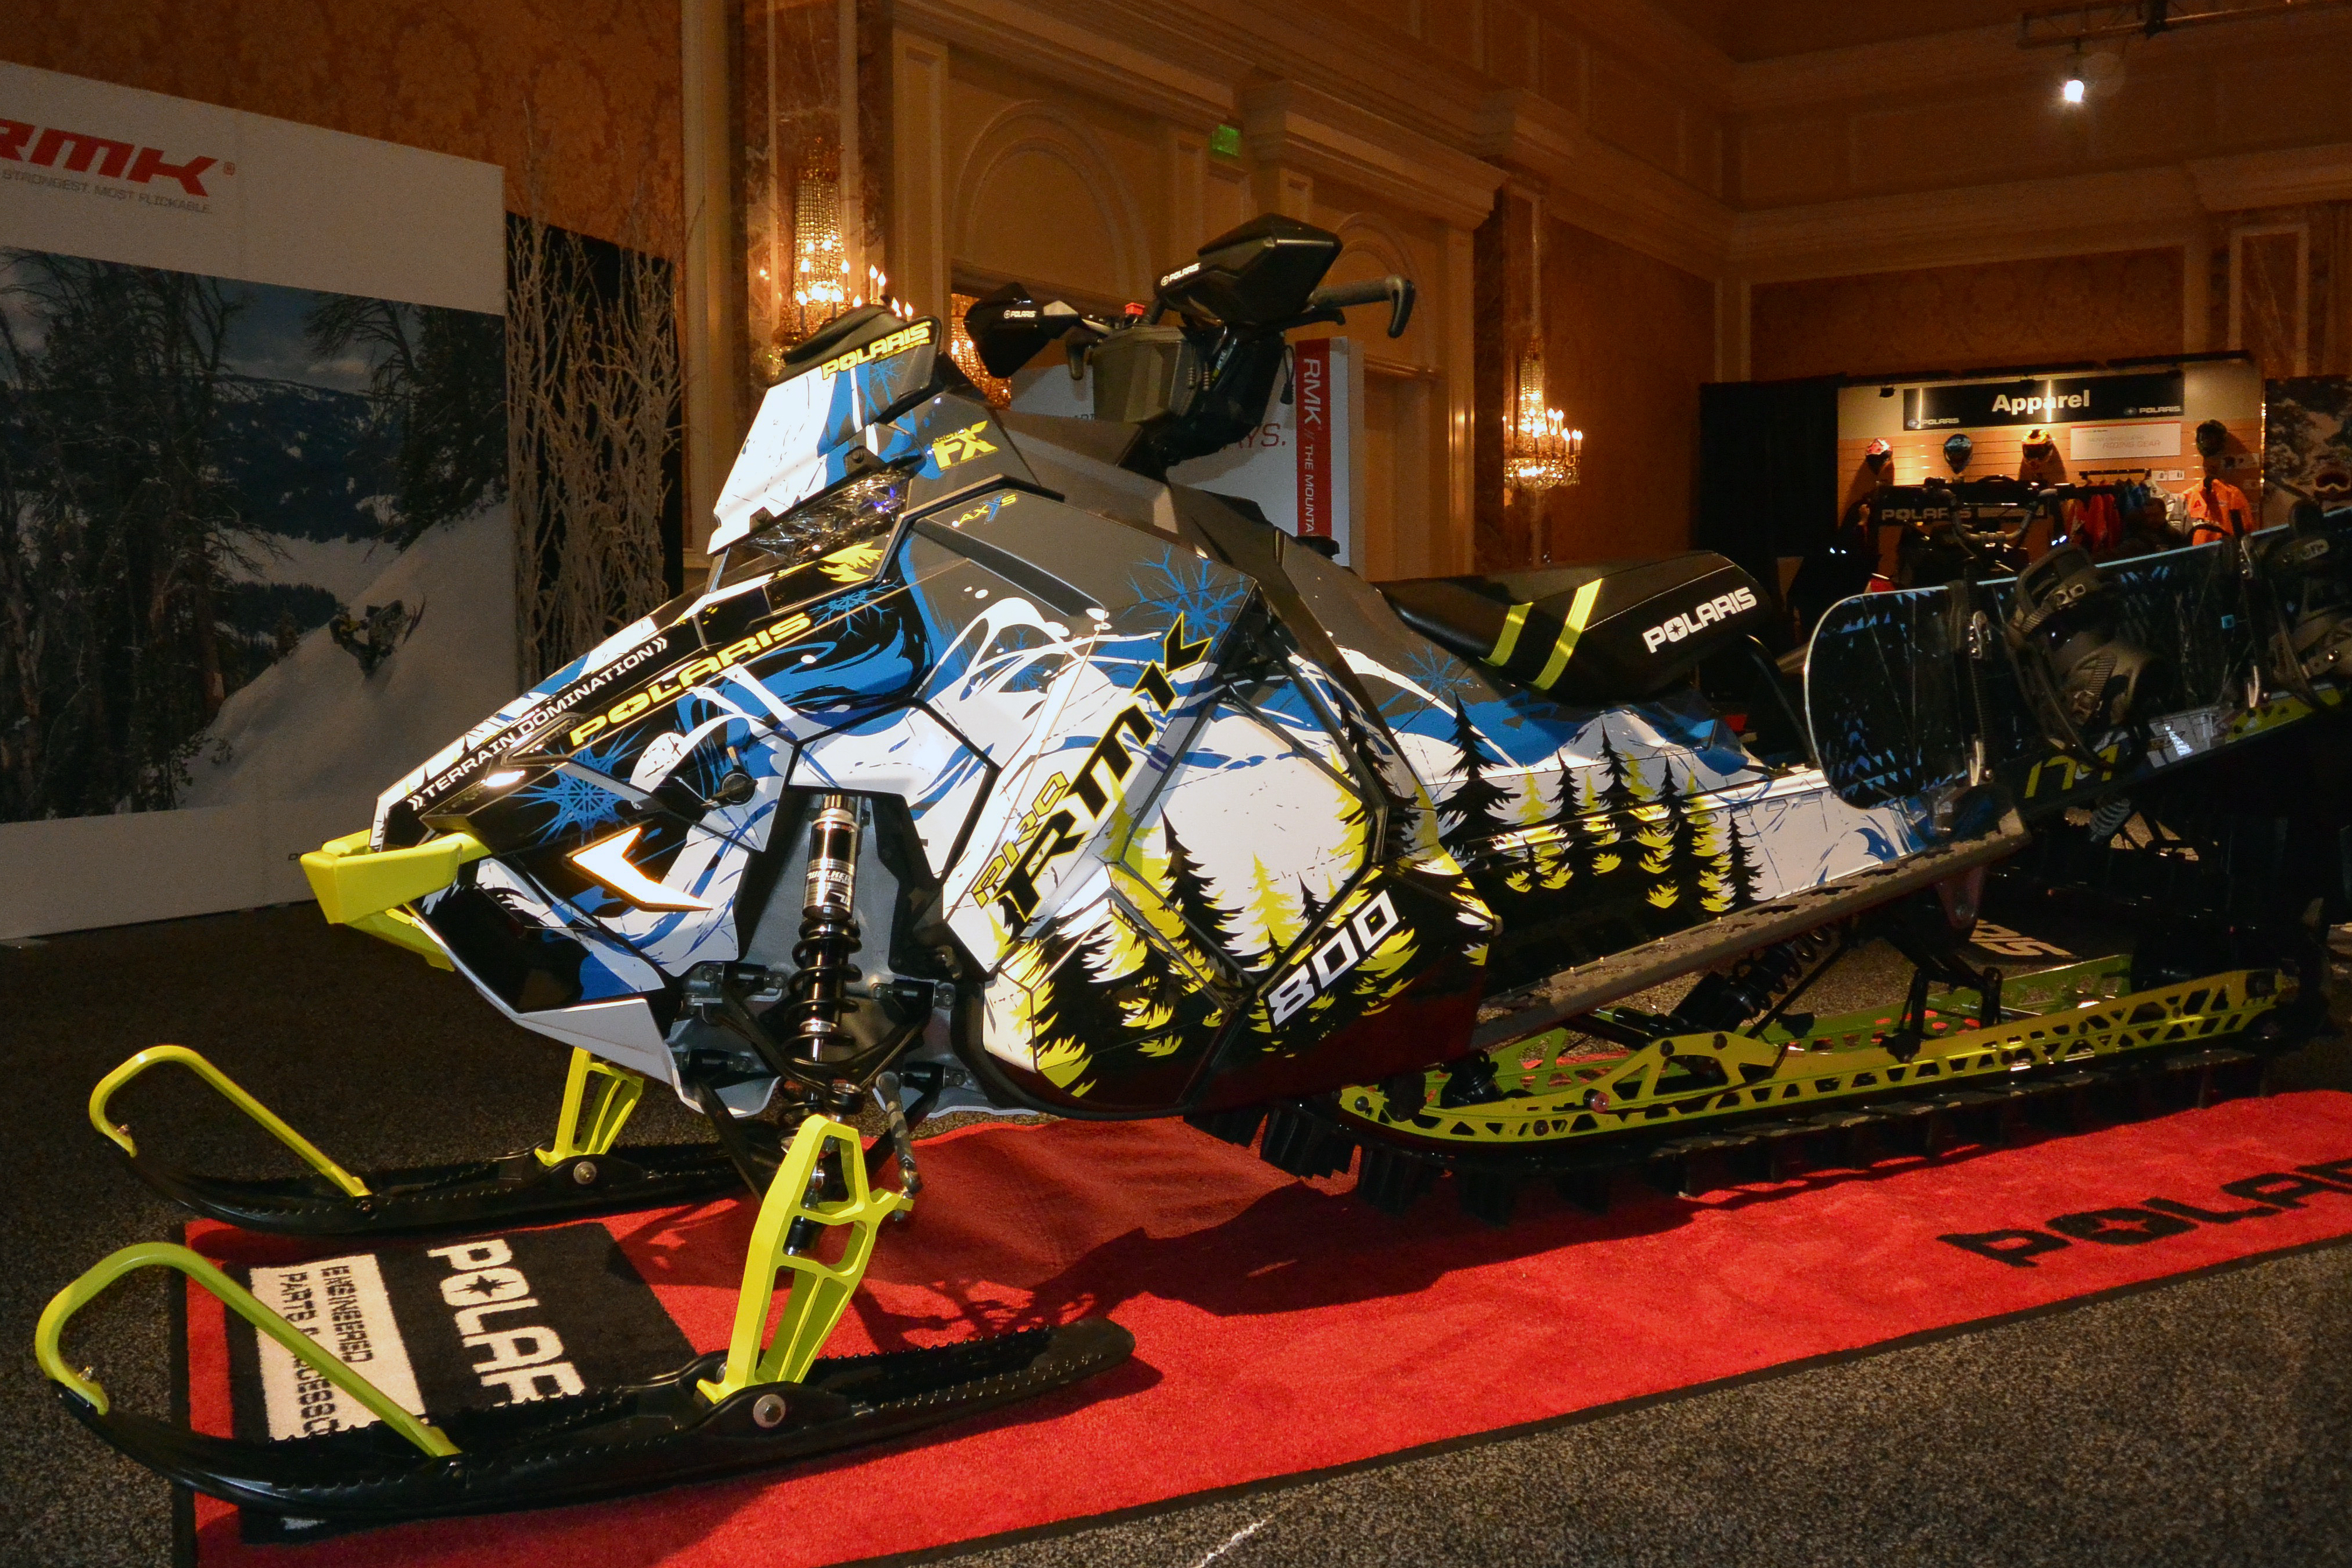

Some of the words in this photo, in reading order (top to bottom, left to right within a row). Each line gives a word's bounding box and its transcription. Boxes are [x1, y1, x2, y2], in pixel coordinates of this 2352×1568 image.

[94, 185, 135, 201] MOST
[1169, 263, 1200, 282] POLARIS
[822, 321, 931, 379] POLARIS
[1921, 417, 1960, 426] POLARIS
[1991, 389, 2090, 415] Apparel
[2139, 405, 2181, 414] POLARIS
[932, 420, 999, 471] FX
[1304, 443, 1314, 470] THE
[1881, 507, 1972, 521] POLARS
[1642, 586, 1757, 654] POLARIS
[569, 612, 813, 747] POLARIS
[422, 731, 517, 799] TERRAIN
[517, 645, 655, 736] DOMINATION
[992, 611, 1213, 923] RMK
[1267, 890, 1400, 1026] 800
[278, 1271, 318, 1323] PARTS
[320, 1265, 374, 1363] ENGINEERED
